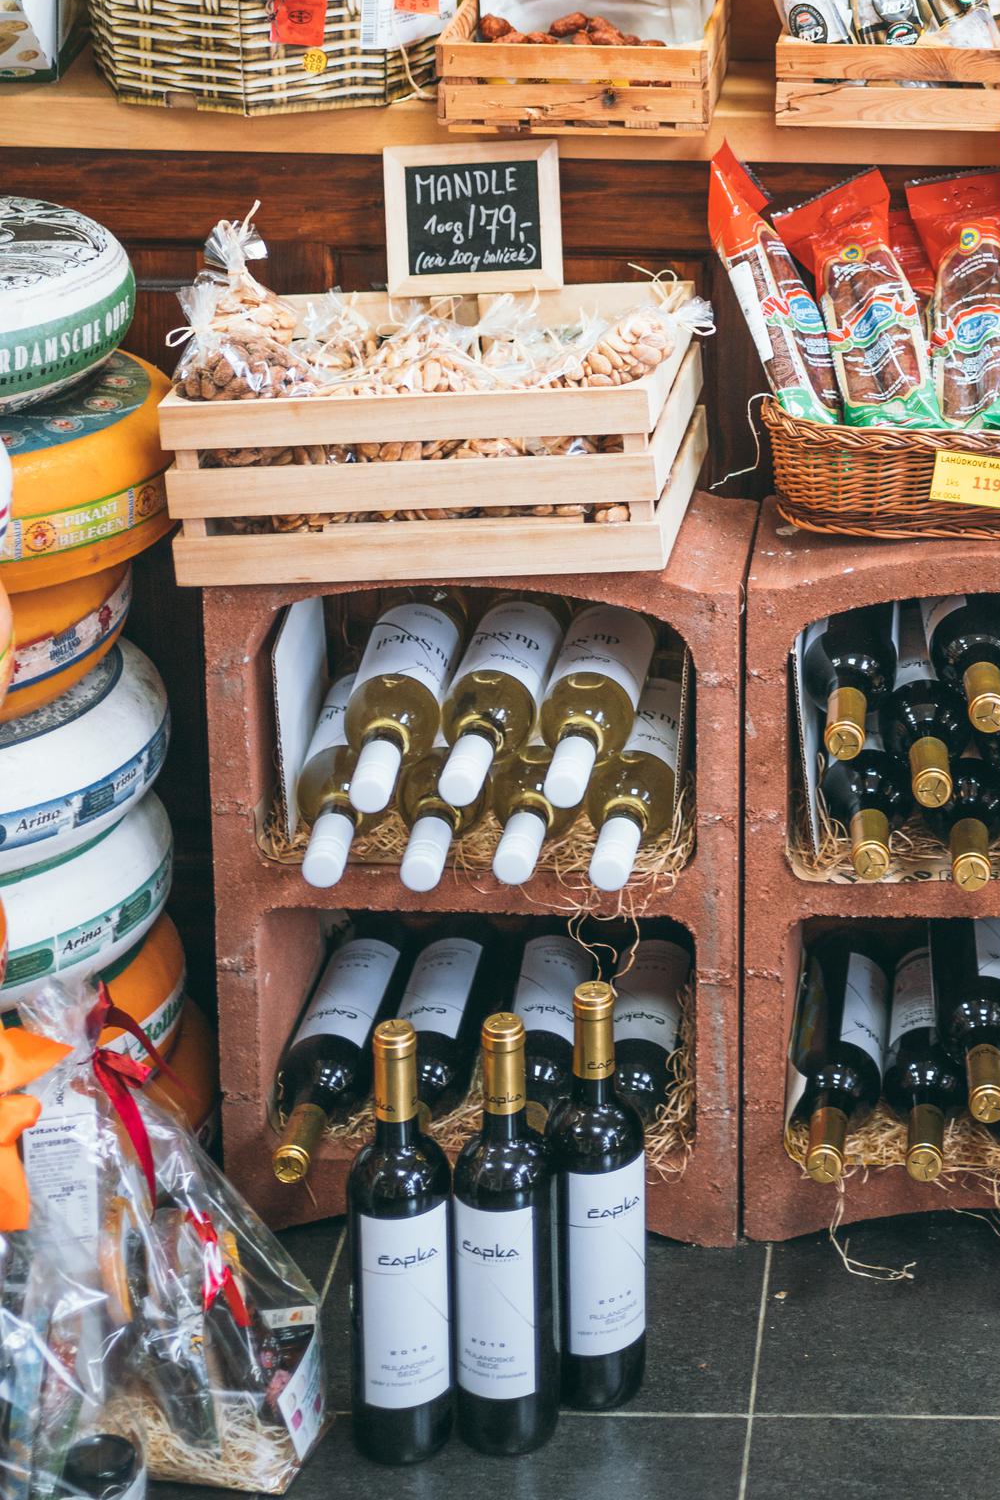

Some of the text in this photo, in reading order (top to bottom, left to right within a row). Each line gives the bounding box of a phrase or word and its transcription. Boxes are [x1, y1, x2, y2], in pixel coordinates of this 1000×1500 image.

[415, 167, 518, 205] MANDLE
[448, 249, 481, 273] 200g
[105, 294, 130, 337] OUDE
[941, 456, 987, 469] LAHŮDKOVÉ
[63, 501, 119, 529] PIKANT
[58, 515, 126, 546] BELEGEN
[15, 767, 137, 834] Arina rina
[62, 925, 103, 955] Arina
[588, 1058, 615, 1072] čap
[587, 1195, 641, 1219] čapka
[378, 1246, 438, 1269] čapka
[462, 1238, 520, 1261] čapka
